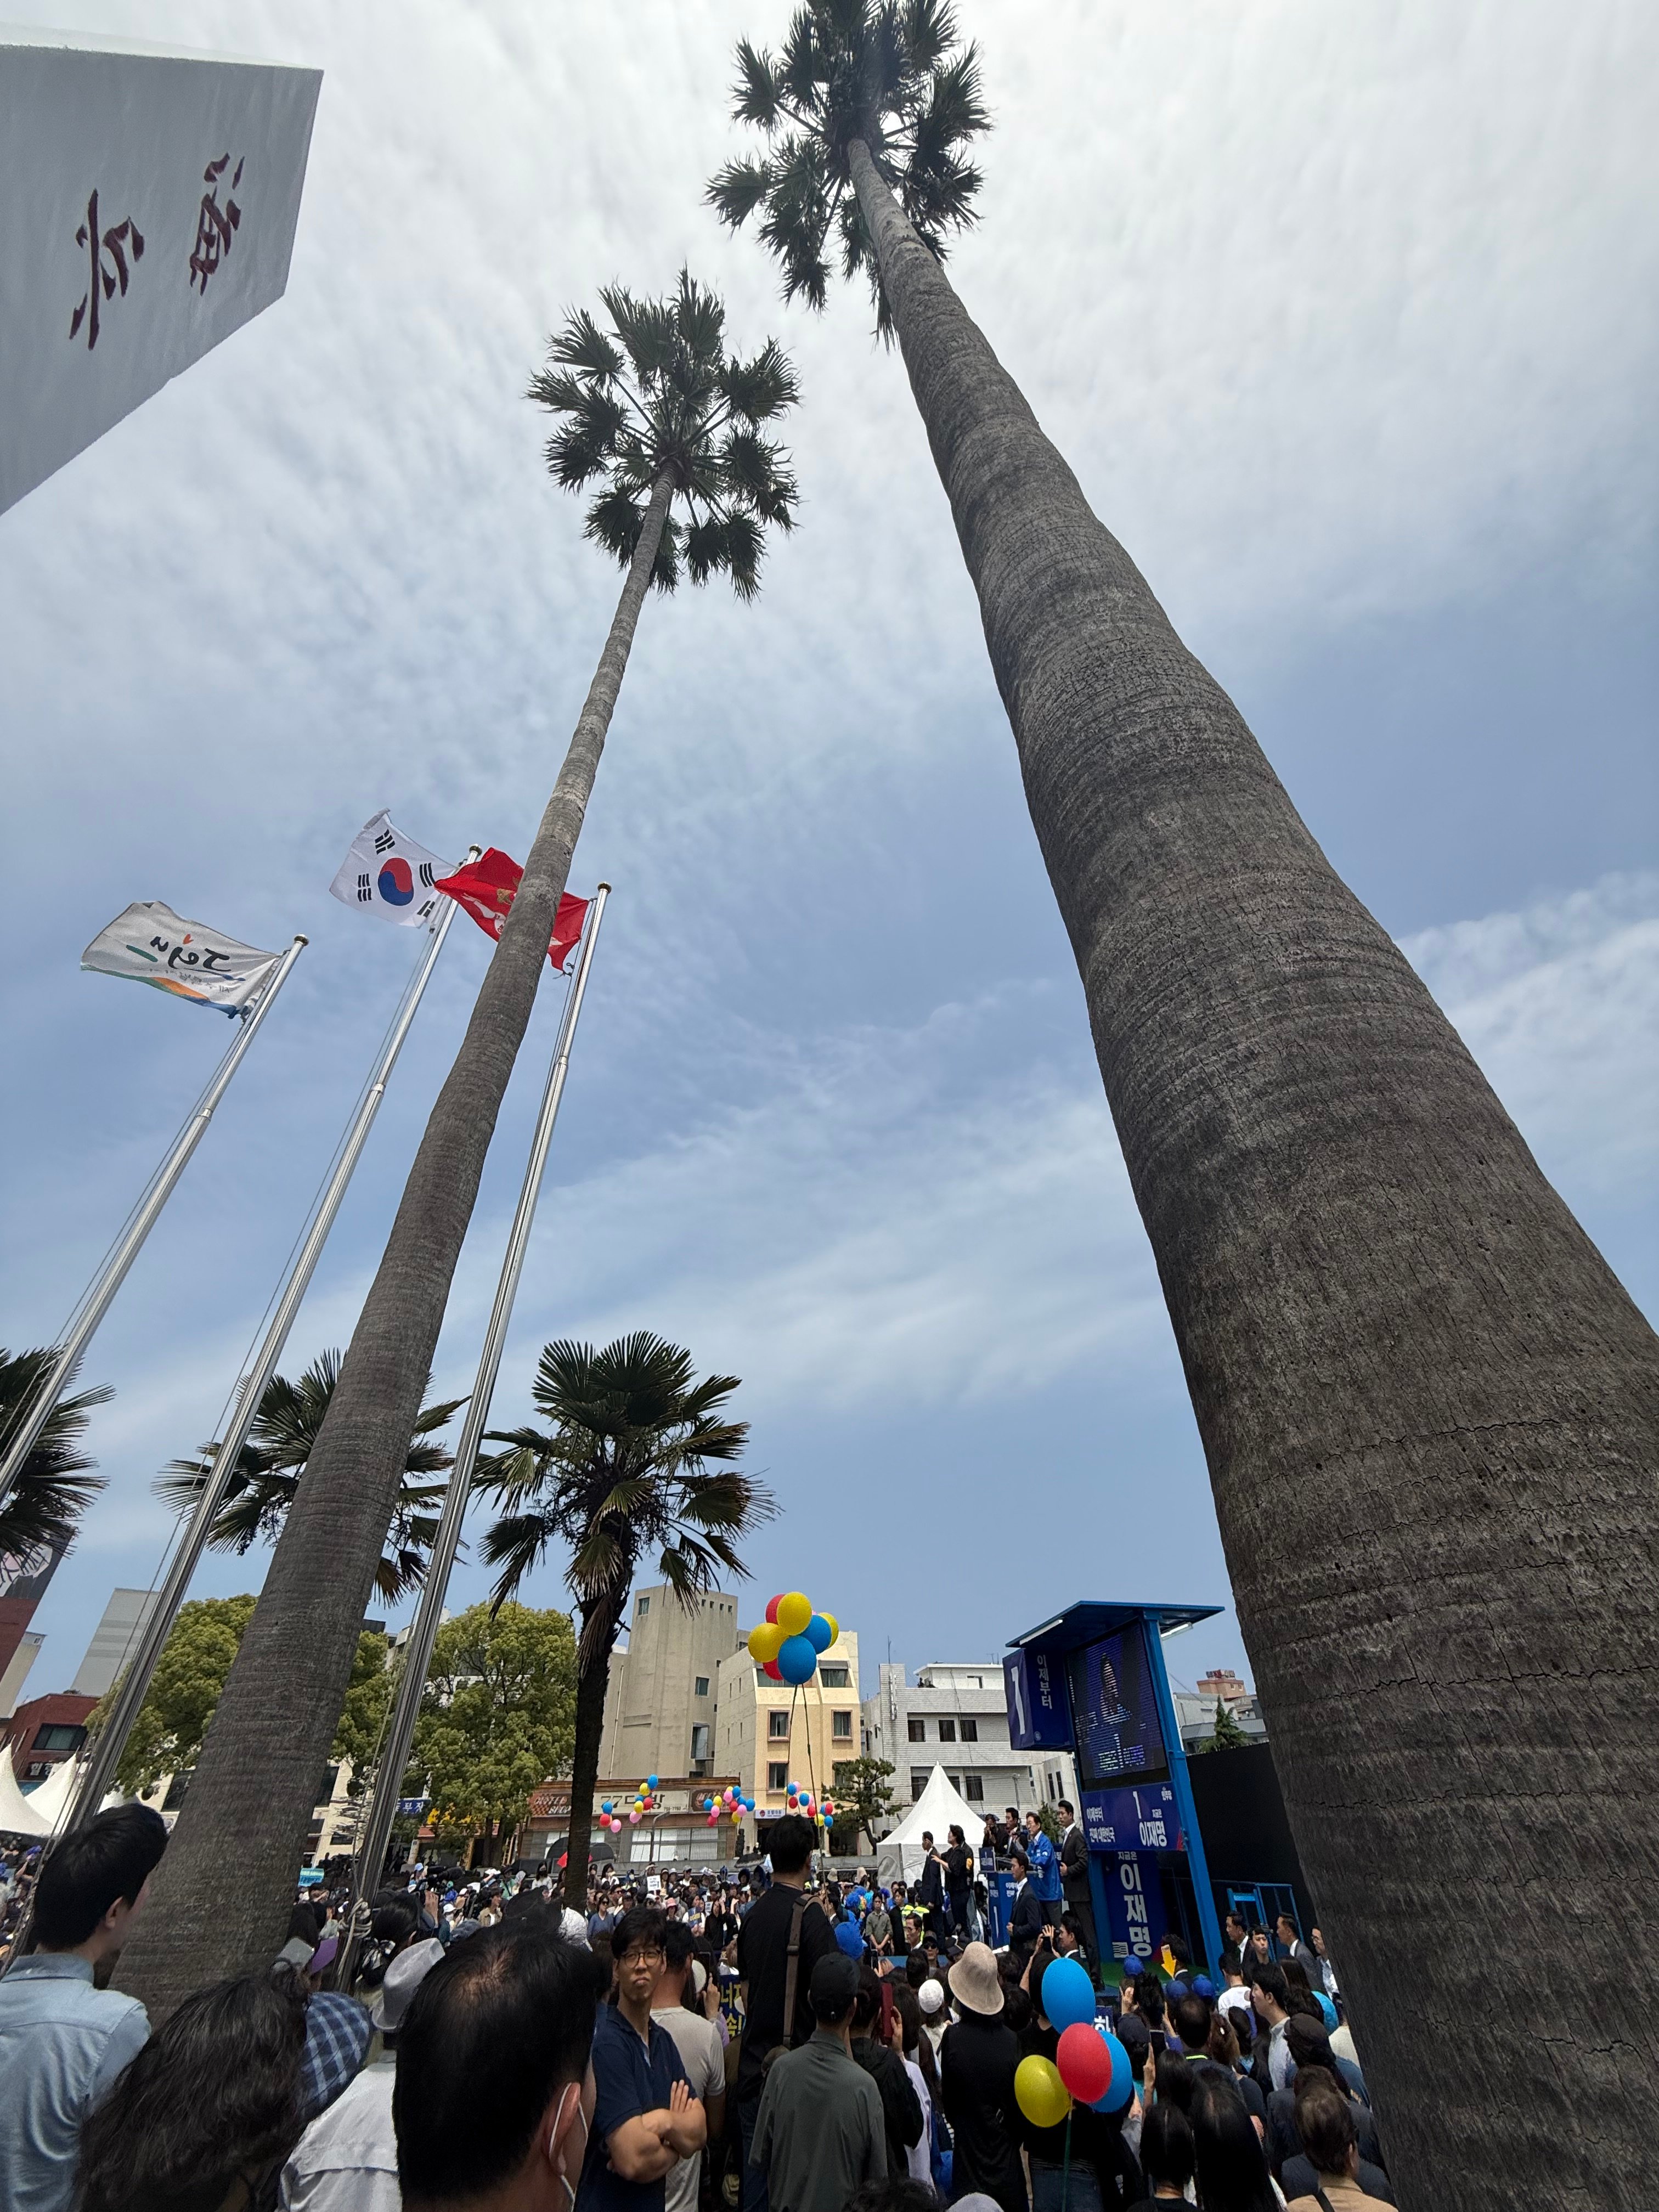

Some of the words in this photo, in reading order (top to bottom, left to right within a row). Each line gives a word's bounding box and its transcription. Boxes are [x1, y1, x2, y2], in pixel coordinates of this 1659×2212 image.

[1037, 1654, 1053, 1710] 이제부터
[1011, 1666, 1026, 1735] 1
[548, 1805, 572, 1814] SHOP
[1132, 1791, 1142, 1819] 1
[1139, 1821, 1167, 1847] 이재명
[1118, 1851, 1137, 1860] 지금은
[1120, 1863, 1153, 1957] 이재명
